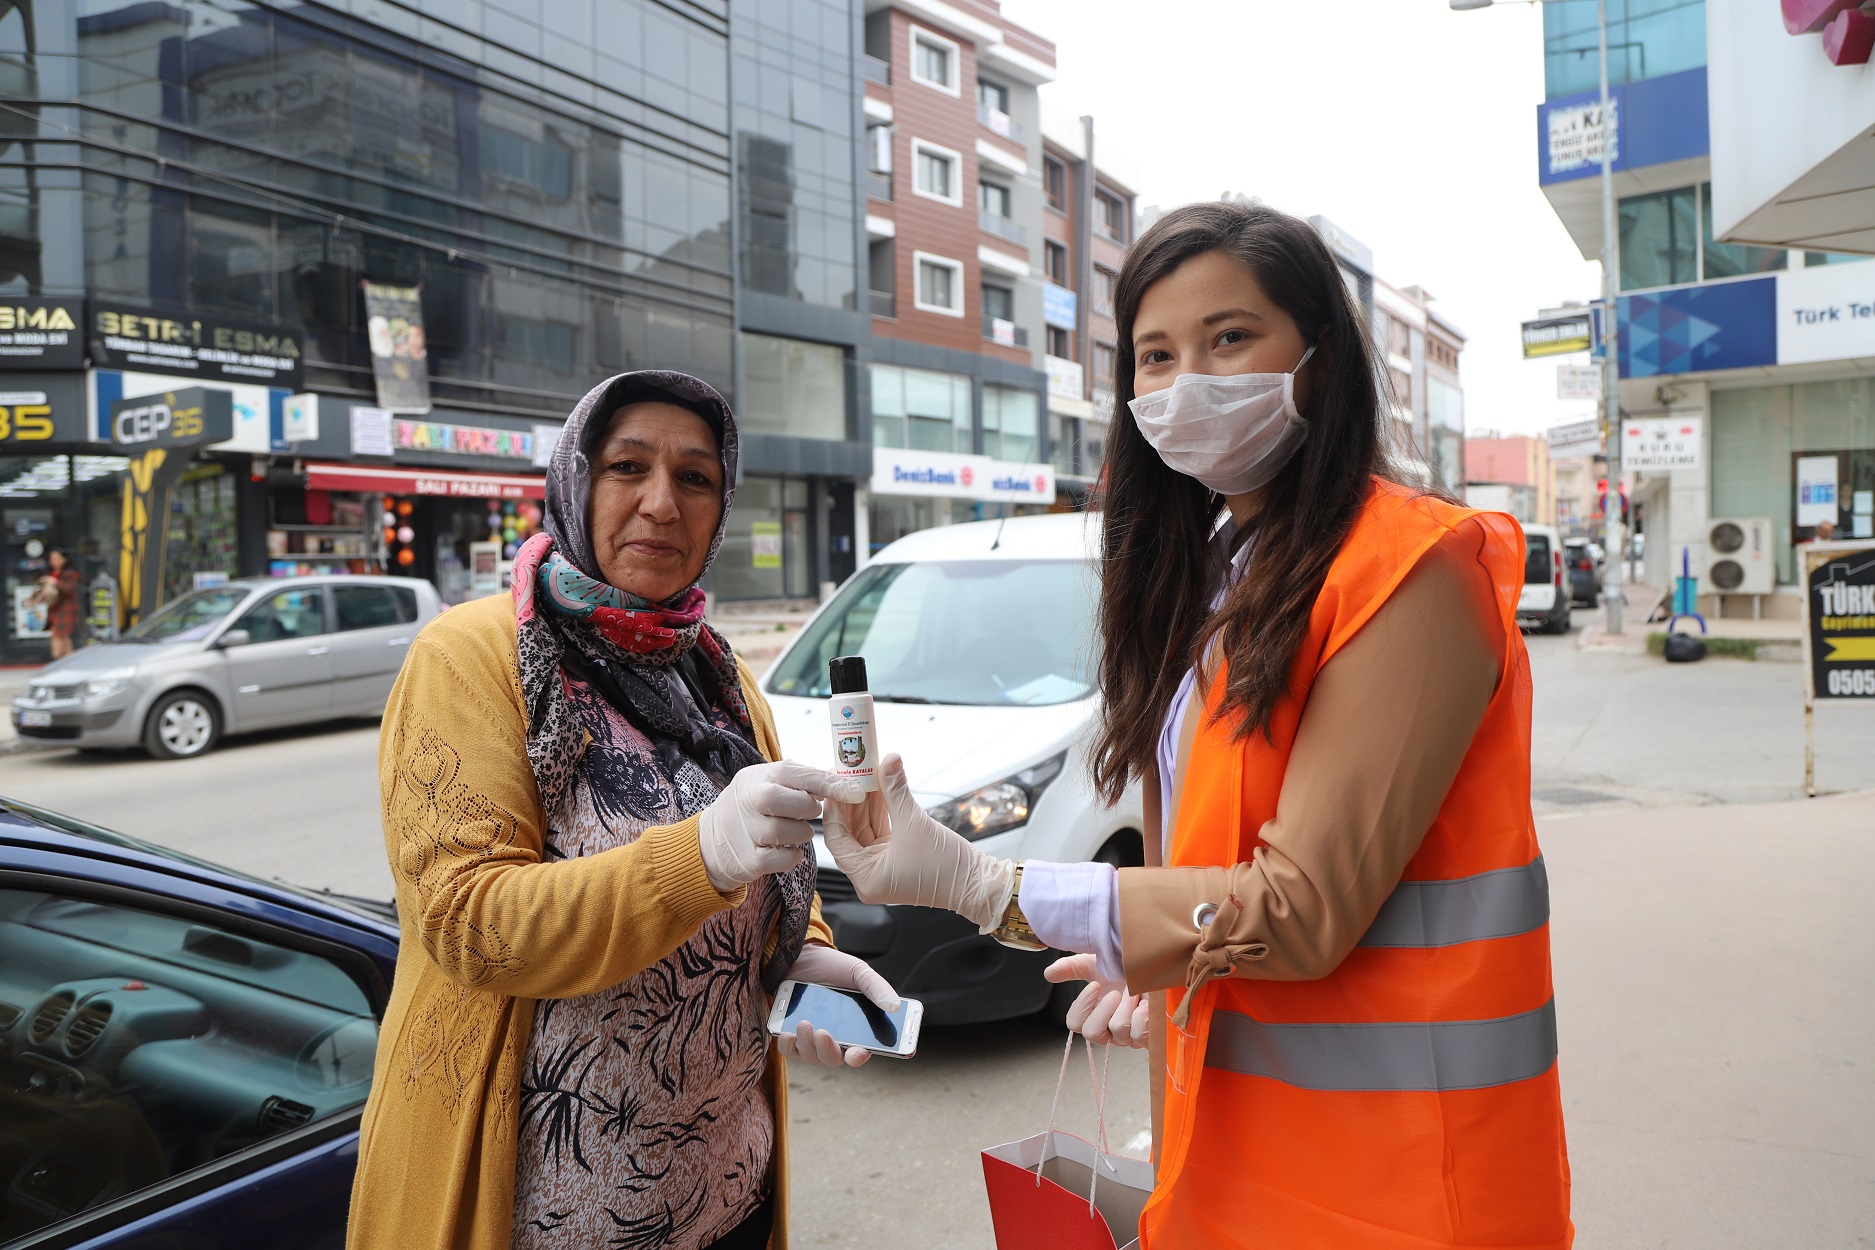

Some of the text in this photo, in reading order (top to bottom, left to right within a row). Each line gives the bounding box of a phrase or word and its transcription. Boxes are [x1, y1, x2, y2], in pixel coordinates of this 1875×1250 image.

[1794, 304, 1841, 326] Türk
[14, 332, 48, 345] MODA
[213, 326, 301, 358] ESMA
[0, 404, 55, 441] 5
[398, 421, 452, 449] SALI
[456, 427, 533, 457] PAZARI
[415, 479, 447, 494] SALI
[450, 481, 501, 497] PAZARI
[893, 465, 956, 485] DenizBank
[1819, 581, 1875, 616] TÜRK
[1828, 669, 1875, 696] 0505
